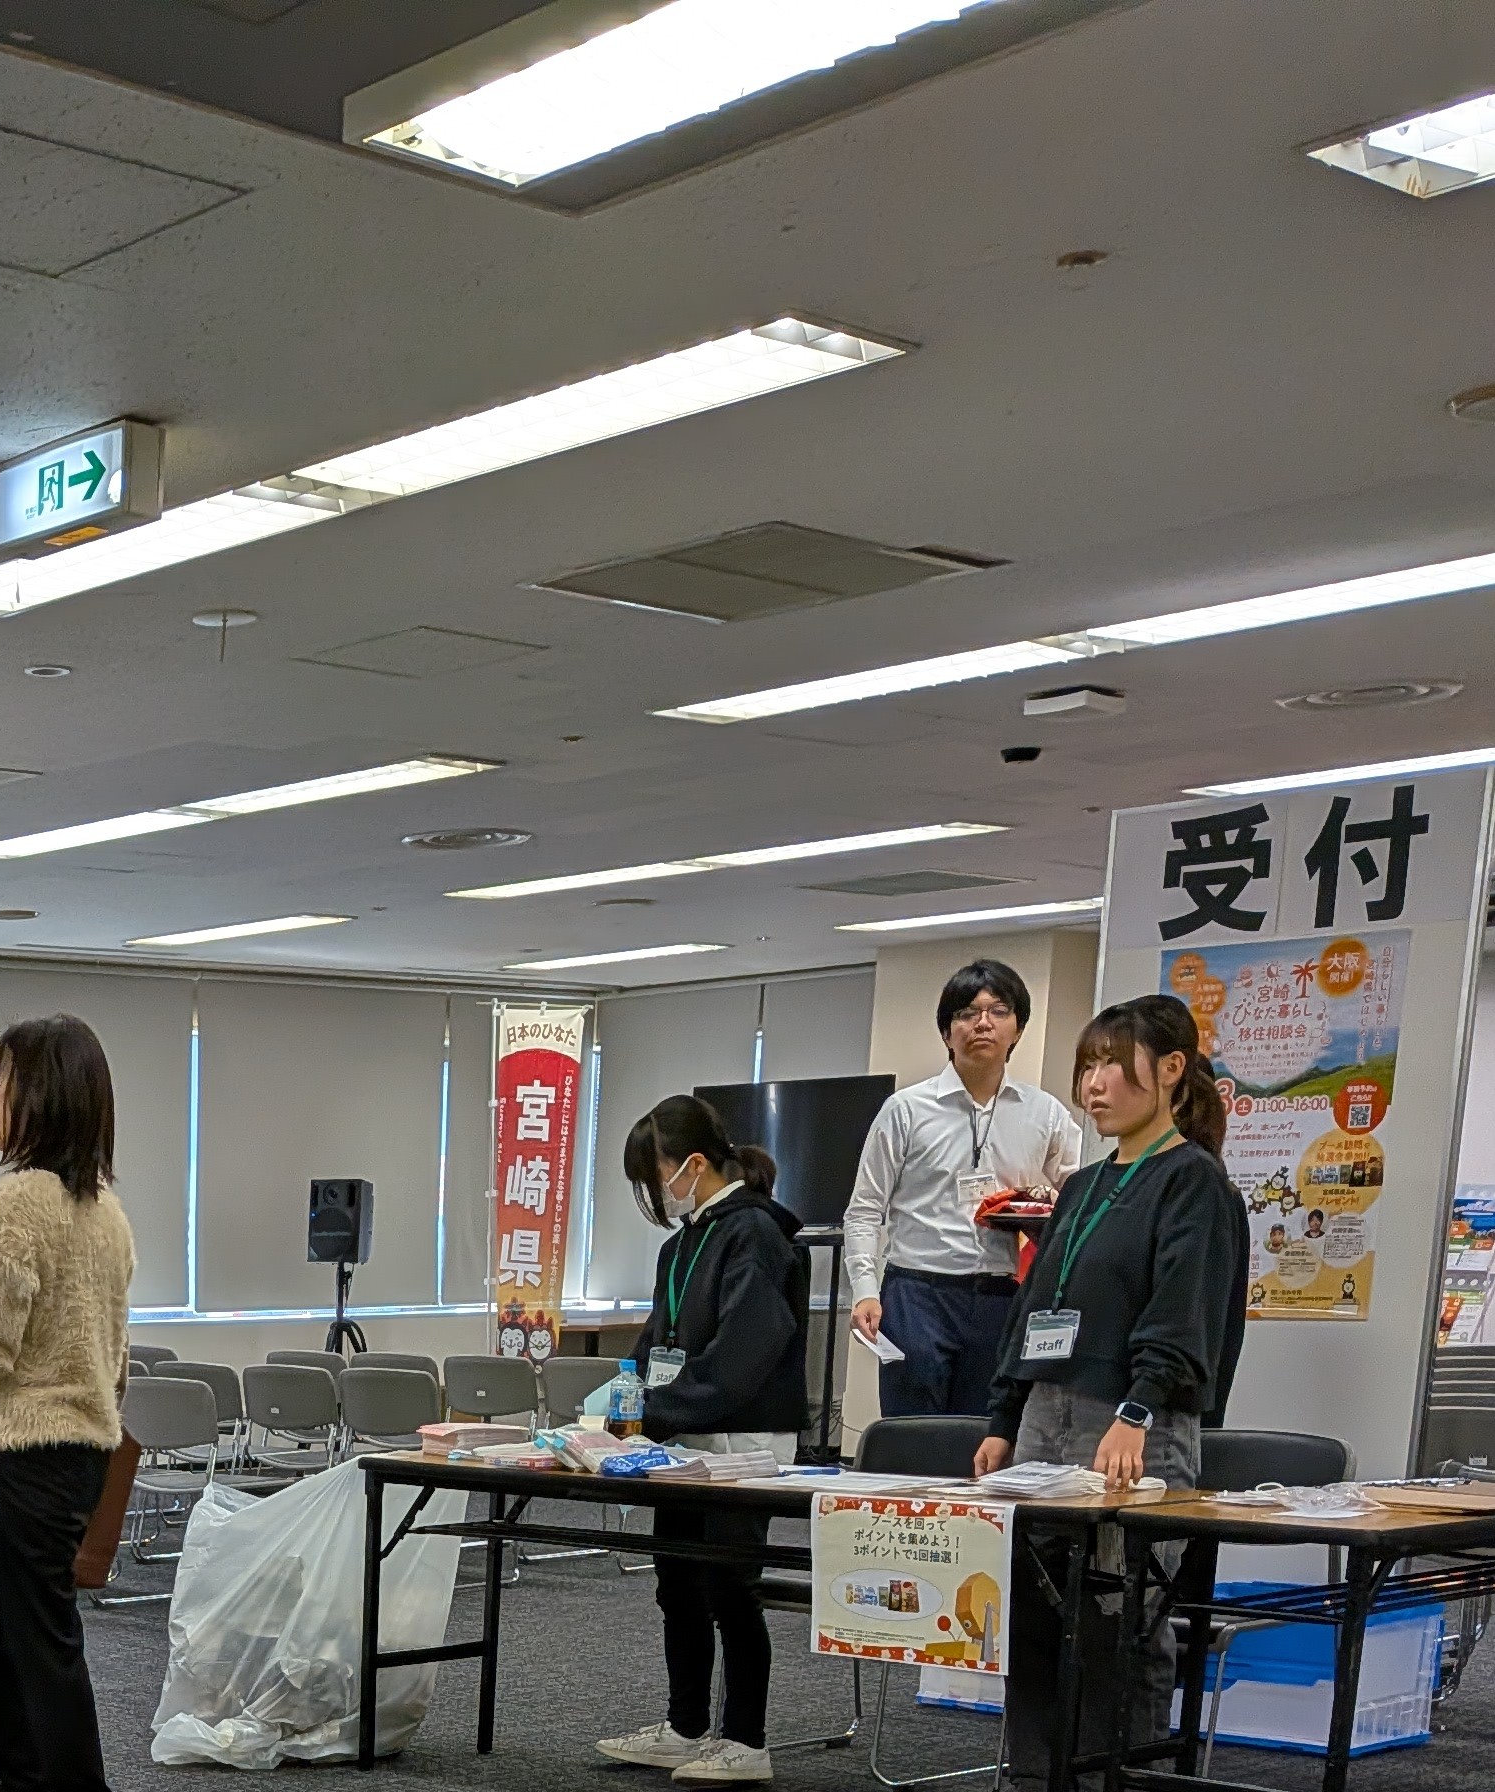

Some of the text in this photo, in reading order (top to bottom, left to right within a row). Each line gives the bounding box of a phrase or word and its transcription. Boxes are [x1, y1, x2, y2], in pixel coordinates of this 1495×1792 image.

[1157, 783, 1431, 943] 受付
[1257, 984, 1291, 1003] 宮崎
[506, 1022, 577, 1047] 日本のひなた
[498, 1078, 557, 1288] 宮崎県
[1035, 1338, 1065, 1352] staff
[871, 1514, 948, 1532] ブースを回って
